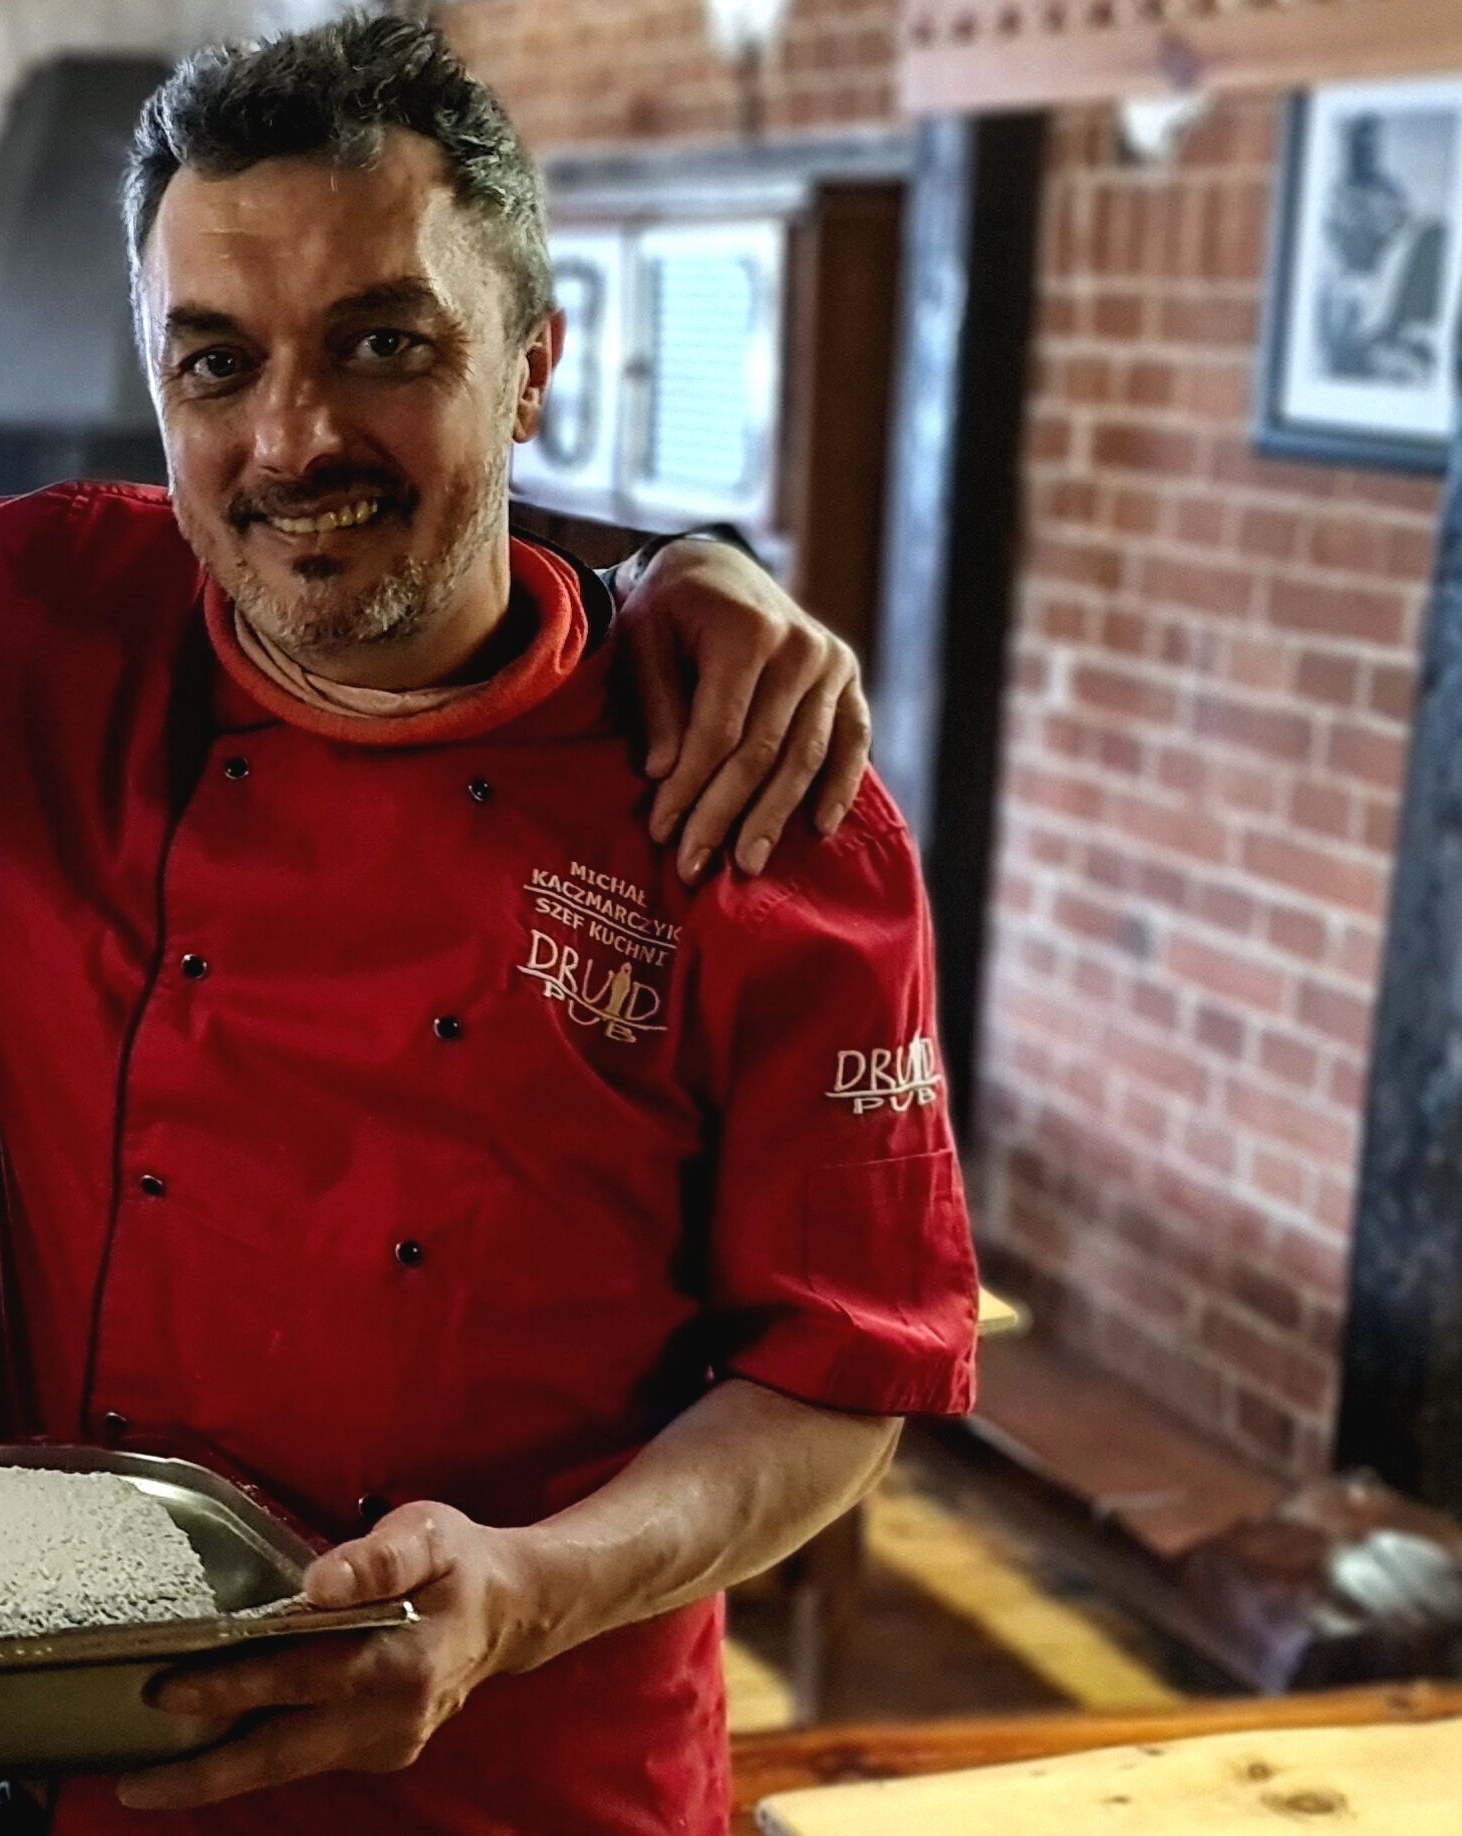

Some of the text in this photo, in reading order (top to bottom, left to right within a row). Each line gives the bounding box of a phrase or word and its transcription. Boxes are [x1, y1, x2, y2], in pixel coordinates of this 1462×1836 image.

[531, 868, 683, 942] KACZMARCZYK
[570, 861, 648, 908] MICHAŁ
[535, 897, 670, 967] SZEF KUCHNI
[526, 929, 661, 1022] DRUID
[542, 979, 638, 1043] PUB
[852, 1087, 938, 1115] PUB
